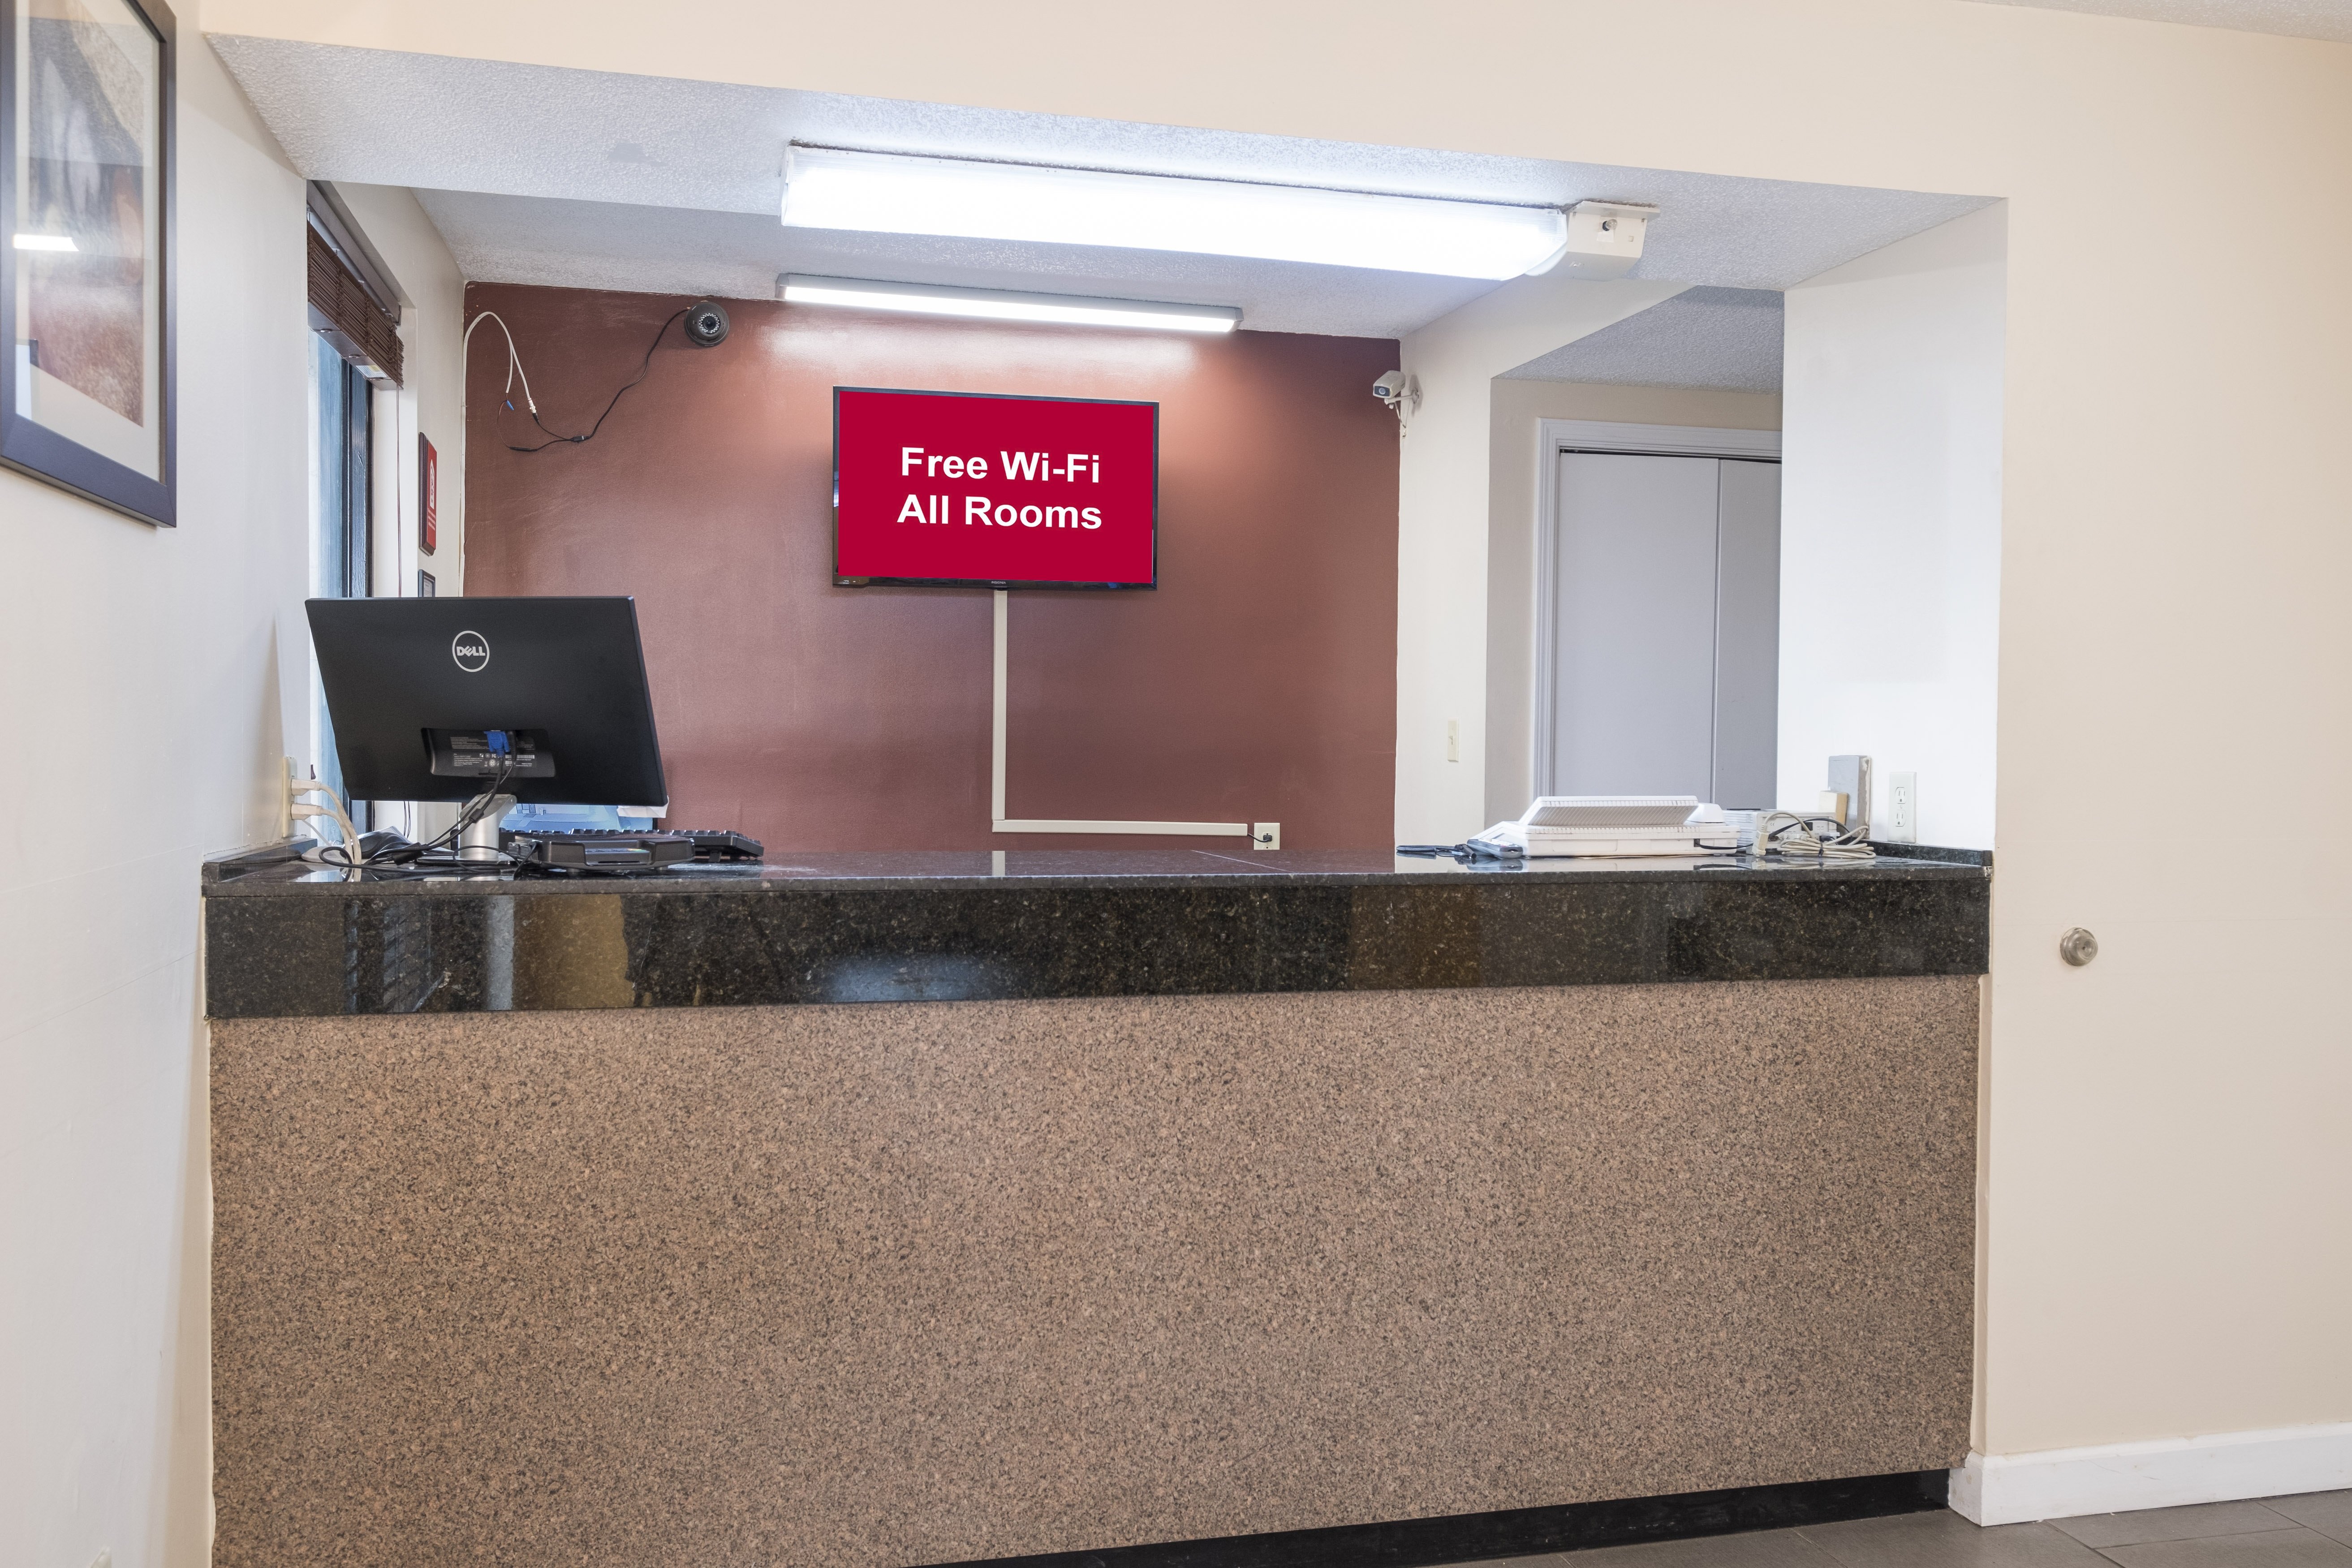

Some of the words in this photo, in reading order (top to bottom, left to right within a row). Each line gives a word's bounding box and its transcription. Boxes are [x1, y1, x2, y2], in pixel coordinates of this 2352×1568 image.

[902, 447, 988, 479] Free
[1000, 451, 1099, 483] Wi-Fi
[896, 494, 949, 524] All
[965, 496, 1102, 529] Rooms
[456, 646, 486, 657] DELL
